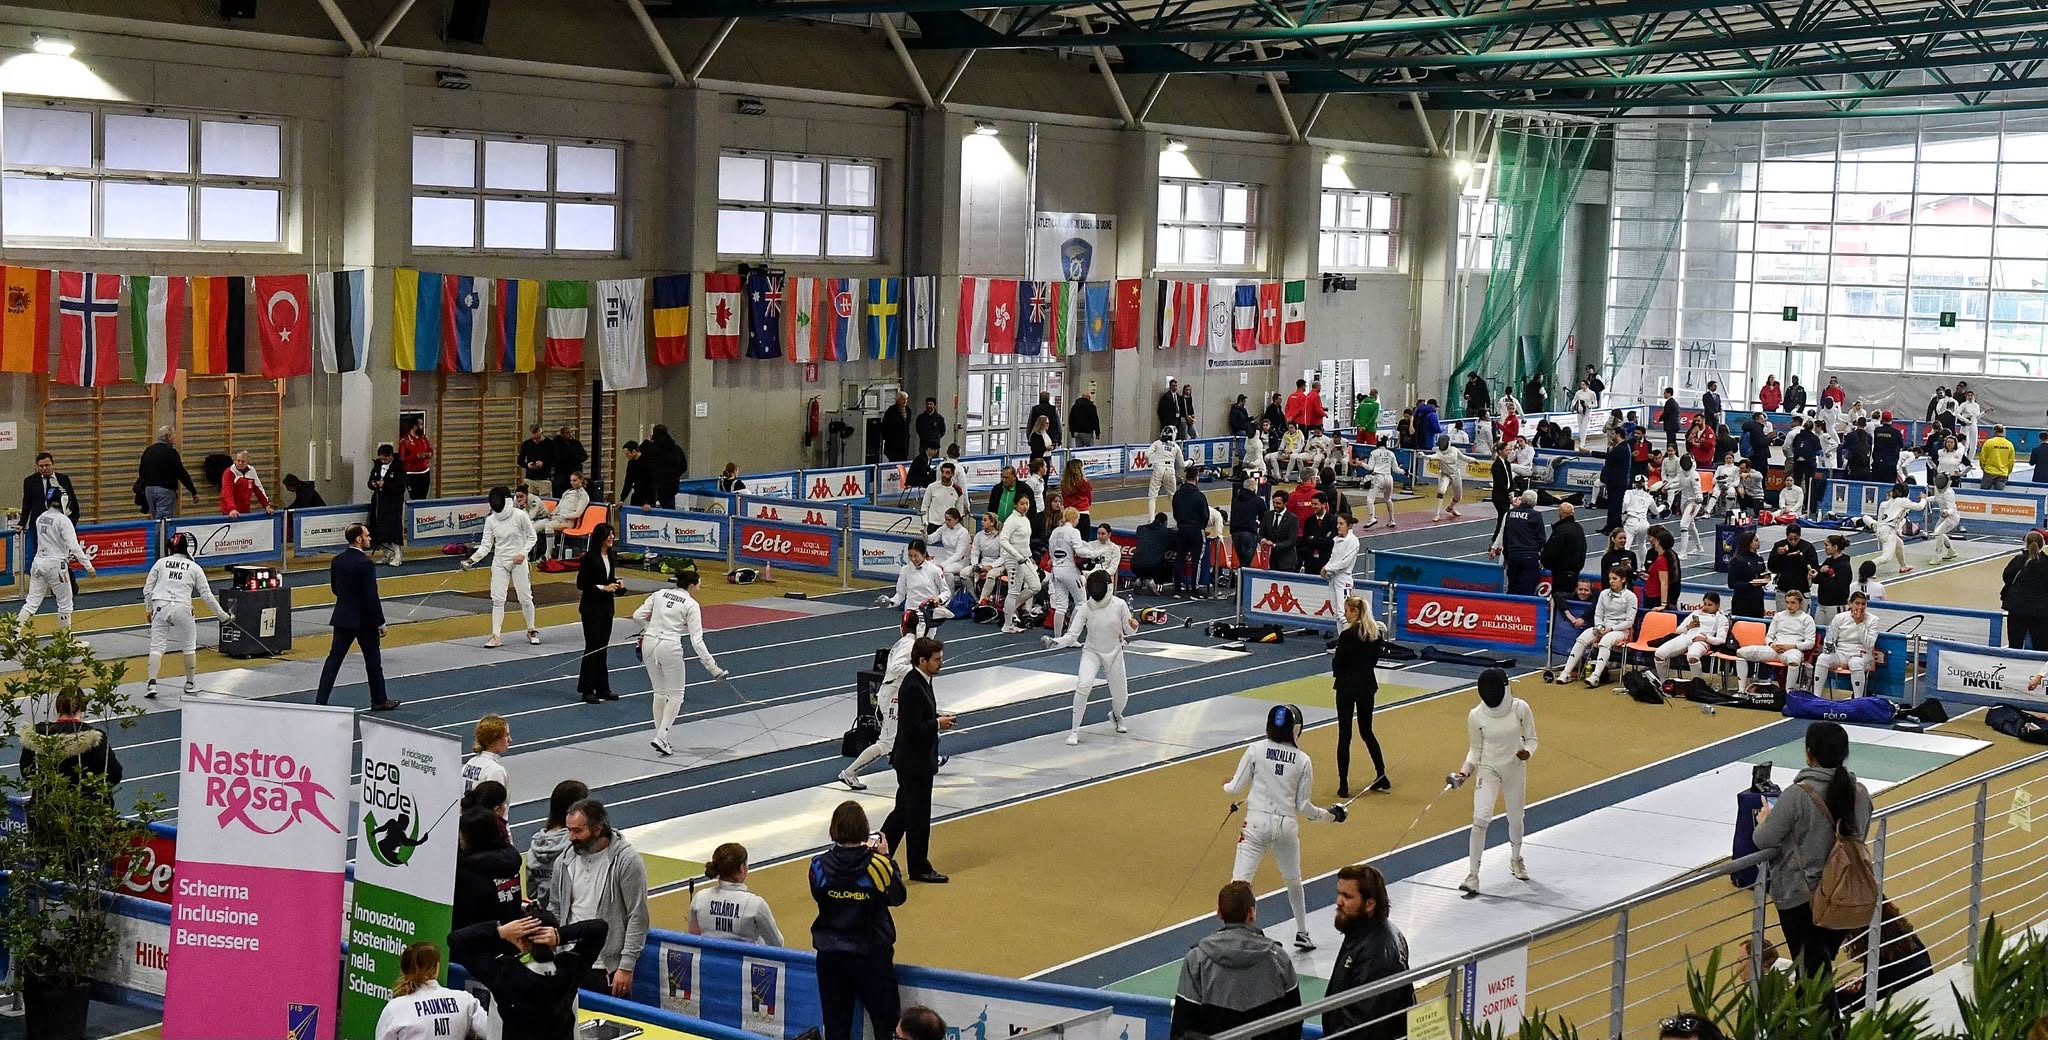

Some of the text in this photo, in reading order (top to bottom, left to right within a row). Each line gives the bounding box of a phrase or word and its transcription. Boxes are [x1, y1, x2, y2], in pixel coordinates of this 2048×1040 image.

[606, 297, 619, 329] FIE
[416, 515, 436, 524] Kinder
[458, 512, 477, 521] Kinder
[1510, 511, 1529, 520] FRANCE
[675, 527, 696, 535] Kinder
[112, 540, 134, 548] ACQUA
[215, 538, 253, 548] Datamining
[742, 530, 792, 554] Lete
[802, 541, 820, 549] ACQUA
[81, 541, 99, 561] te
[101, 546, 144, 556] DELLO SPORT
[793, 546, 829, 557] DELLO SPORT
[862, 548, 885, 556] Kinder
[165, 560, 180, 569] CHAN
[169, 571, 183, 580] HKG
[1680, 602, 1703, 611] Kind
[1408, 601, 1479, 630] Lete
[1494, 614, 1521, 623] ACQUA
[264, 619, 275, 631] 14
[1481, 620, 1534, 632] DELLO SPORT
[1947, 666, 2005, 681] SuperAbile
[1963, 677, 2002, 690] INAIL
[188, 742, 296, 779] Nastro
[406, 748, 434, 763] riciclaggio
[365, 757, 400, 785] eco
[410, 759, 437, 776] Maraging
[206, 776, 288, 812] Rosa
[363, 778, 411, 814] blade
[122, 847, 174, 893] Le
[179, 878, 249, 900] Scherma
[827, 890, 871, 901] COLOMBIA
[177, 903, 259, 926] Inclusione
[709, 899, 734, 917] SZILÁRD
[354, 902, 416, 936] Innovazione
[715, 917, 733, 933] HUN
[176, 928, 260, 951] Benessere
[351, 952, 376, 973] nella
[668, 952, 682, 962] FIS
[752, 966, 766, 977] FIS
[348, 972, 394, 1002] Scherma
[1487, 975, 1515, 996] WASTE
[414, 997, 460, 1017] PAUKNER
[1482, 993, 1518, 1018] SORTING
[434, 1017, 451, 1036] AUT
